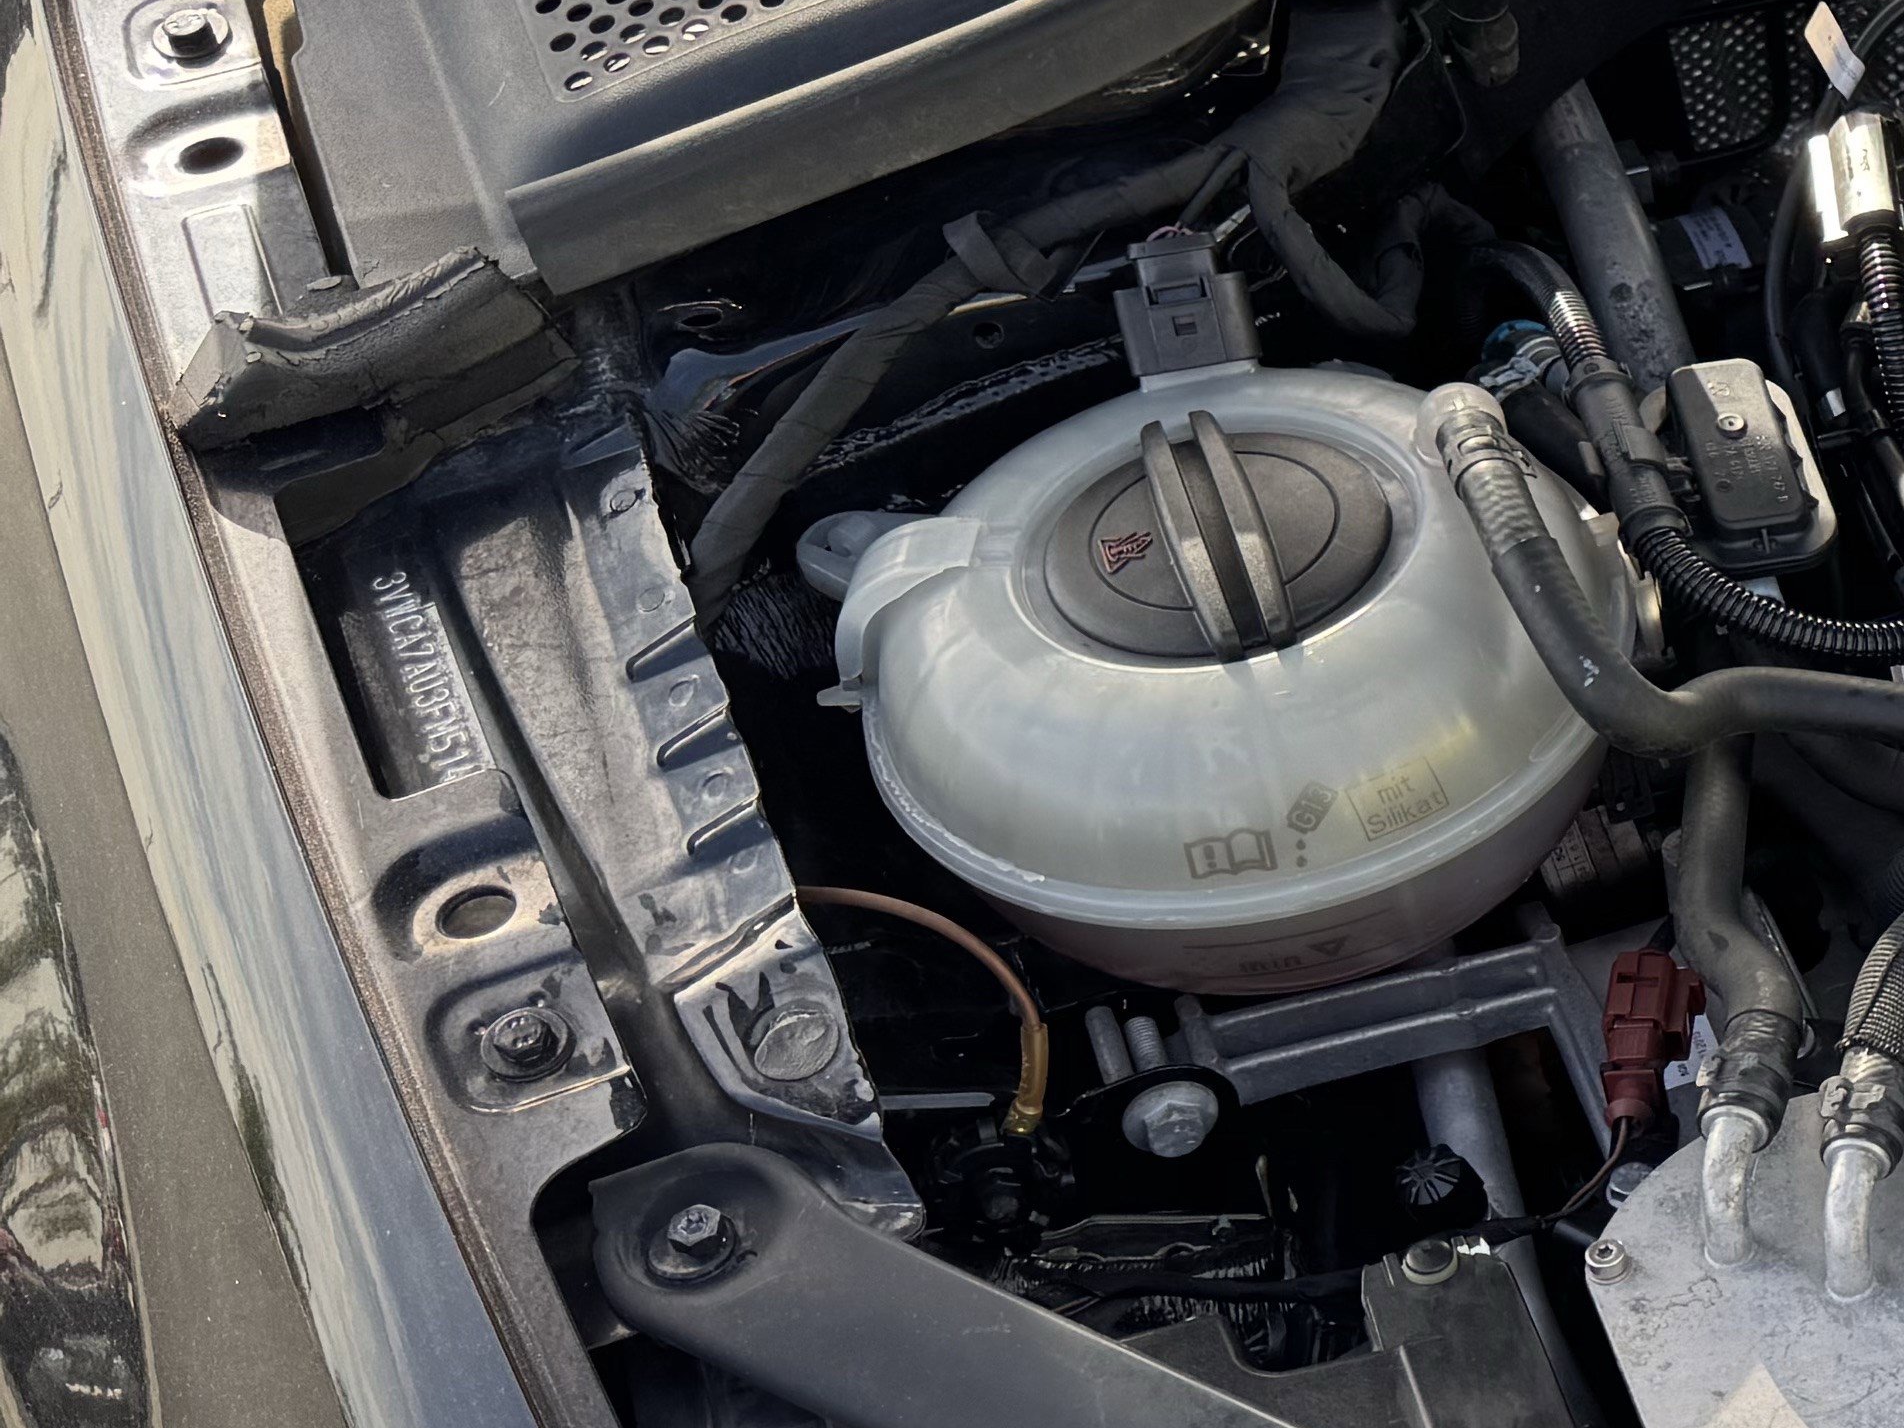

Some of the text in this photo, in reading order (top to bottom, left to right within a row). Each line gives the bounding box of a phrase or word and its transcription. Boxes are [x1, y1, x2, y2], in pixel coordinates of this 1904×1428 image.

[1292, 784, 1334, 830] G13
[1367, 789, 1444, 836] Silikat
[1377, 774, 1417, 805] mit
